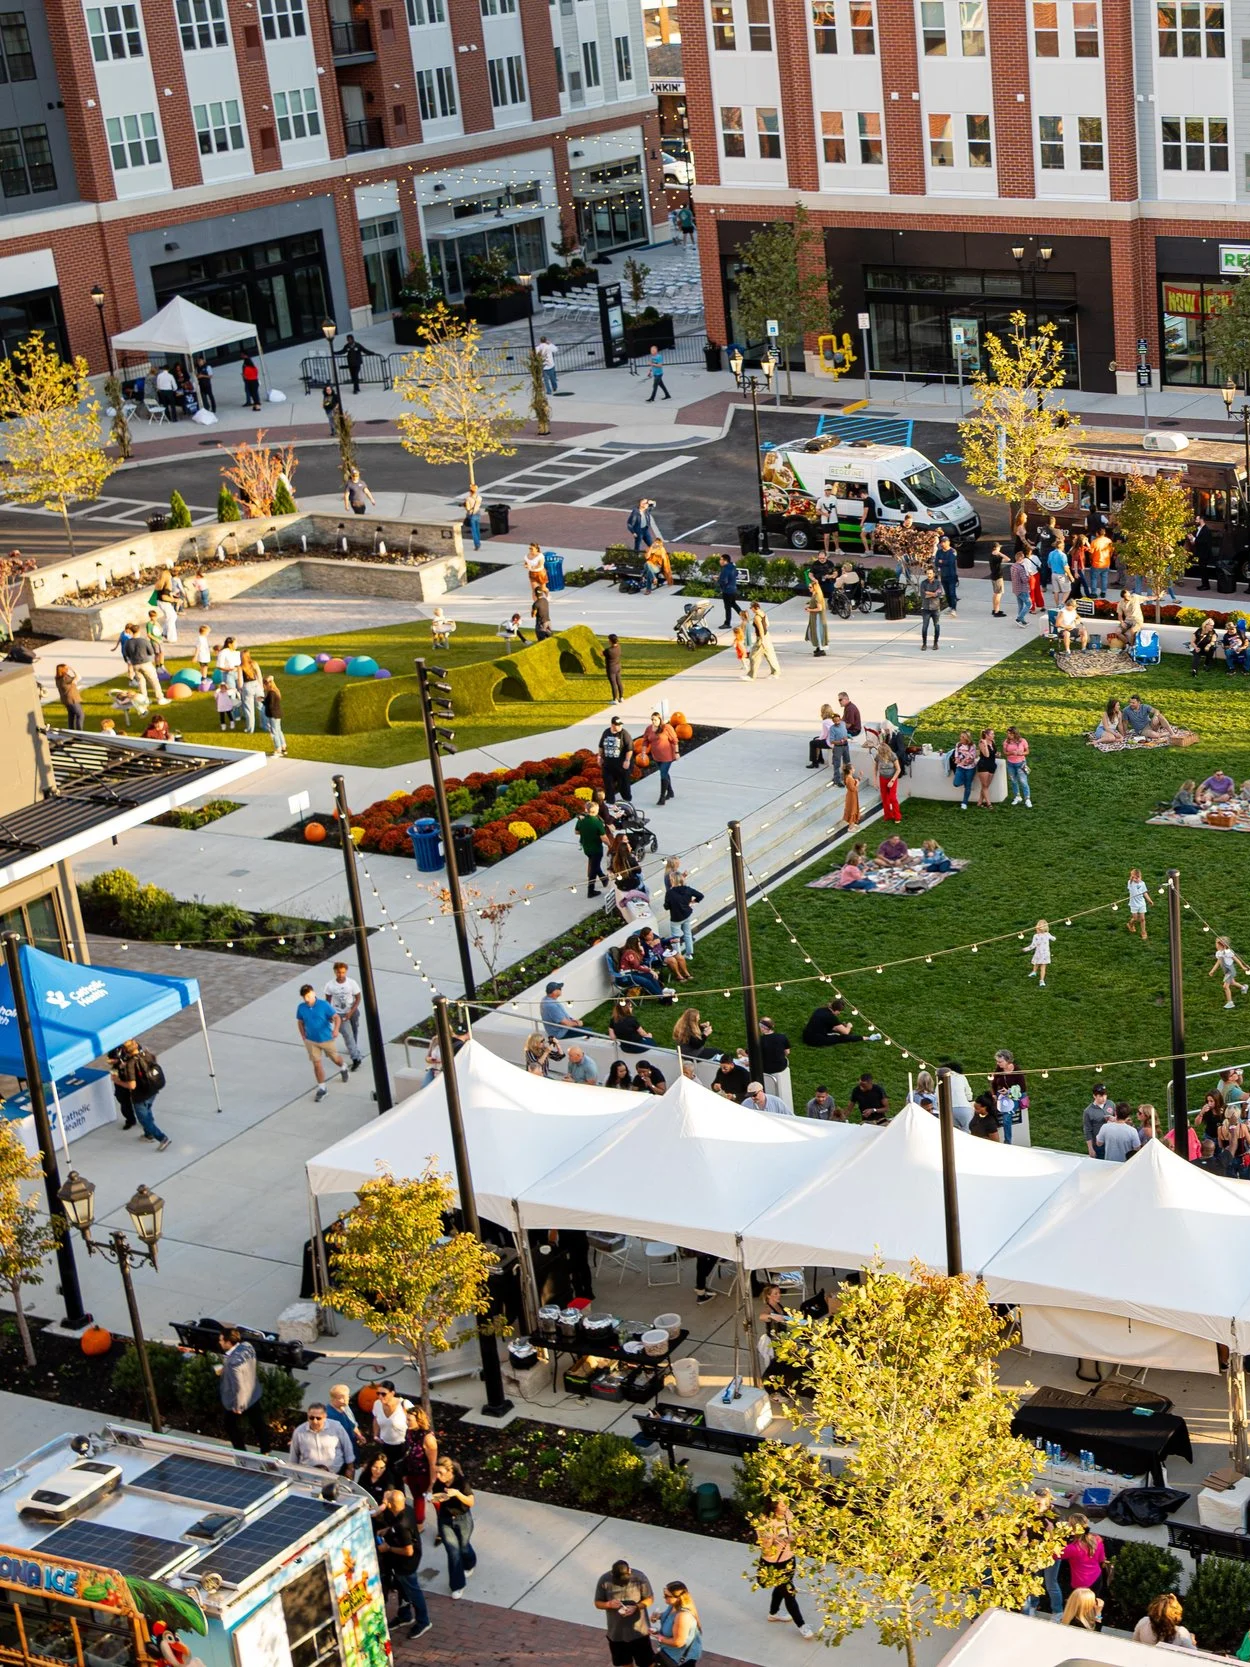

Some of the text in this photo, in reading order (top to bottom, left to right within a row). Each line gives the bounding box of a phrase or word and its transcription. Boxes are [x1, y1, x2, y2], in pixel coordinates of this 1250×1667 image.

[651, 83, 681, 92] NKIN'
[830, 467, 864, 478] REDEFINE
[69, 980, 106, 1000] Catholic
[77, 988, 109, 1008] Health
[0, 1555, 78, 1598] ONA ICE
